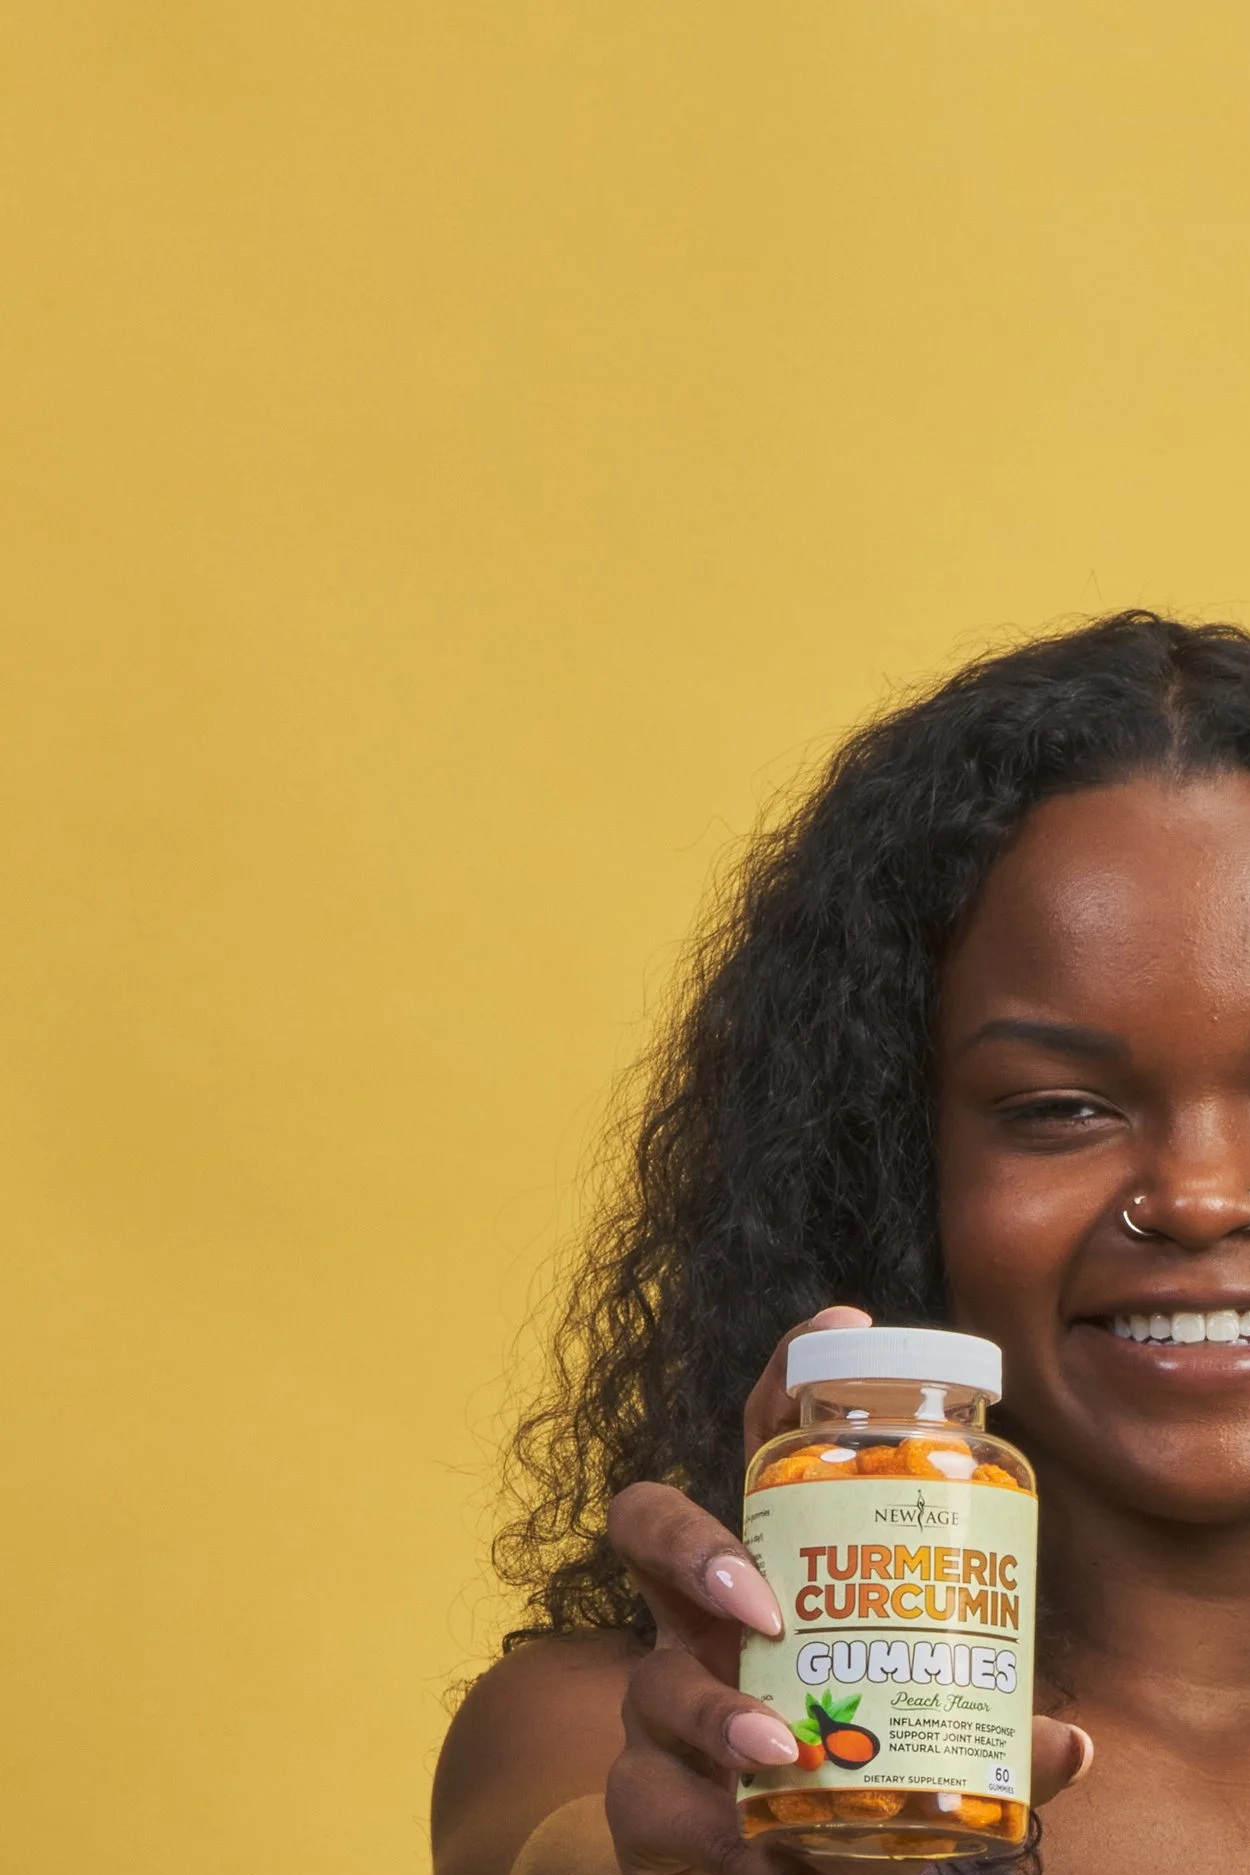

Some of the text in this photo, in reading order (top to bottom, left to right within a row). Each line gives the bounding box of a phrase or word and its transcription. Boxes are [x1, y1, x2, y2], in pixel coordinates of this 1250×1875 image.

[875, 1508, 959, 1526] NEW AGE
[799, 1544, 1018, 1592] TURMERIC
[795, 1583, 1019, 1631] CURCUMIN
[796, 1640, 1017, 1695] GUMMIES
[890, 1691, 991, 1712] Peach Flavor
[889, 1717, 973, 1730] INFLAMMATORY
[889, 1730, 940, 1741] SUPPORT
[942, 1733, 972, 1743] JOINT
[889, 1743, 940, 1754] NATURAL
[863, 1774, 968, 1787] DIETARY SUPPLEMENT
[995, 1767, 1010, 1783] 60
[988, 1783, 1015, 1795] GUMMIES
